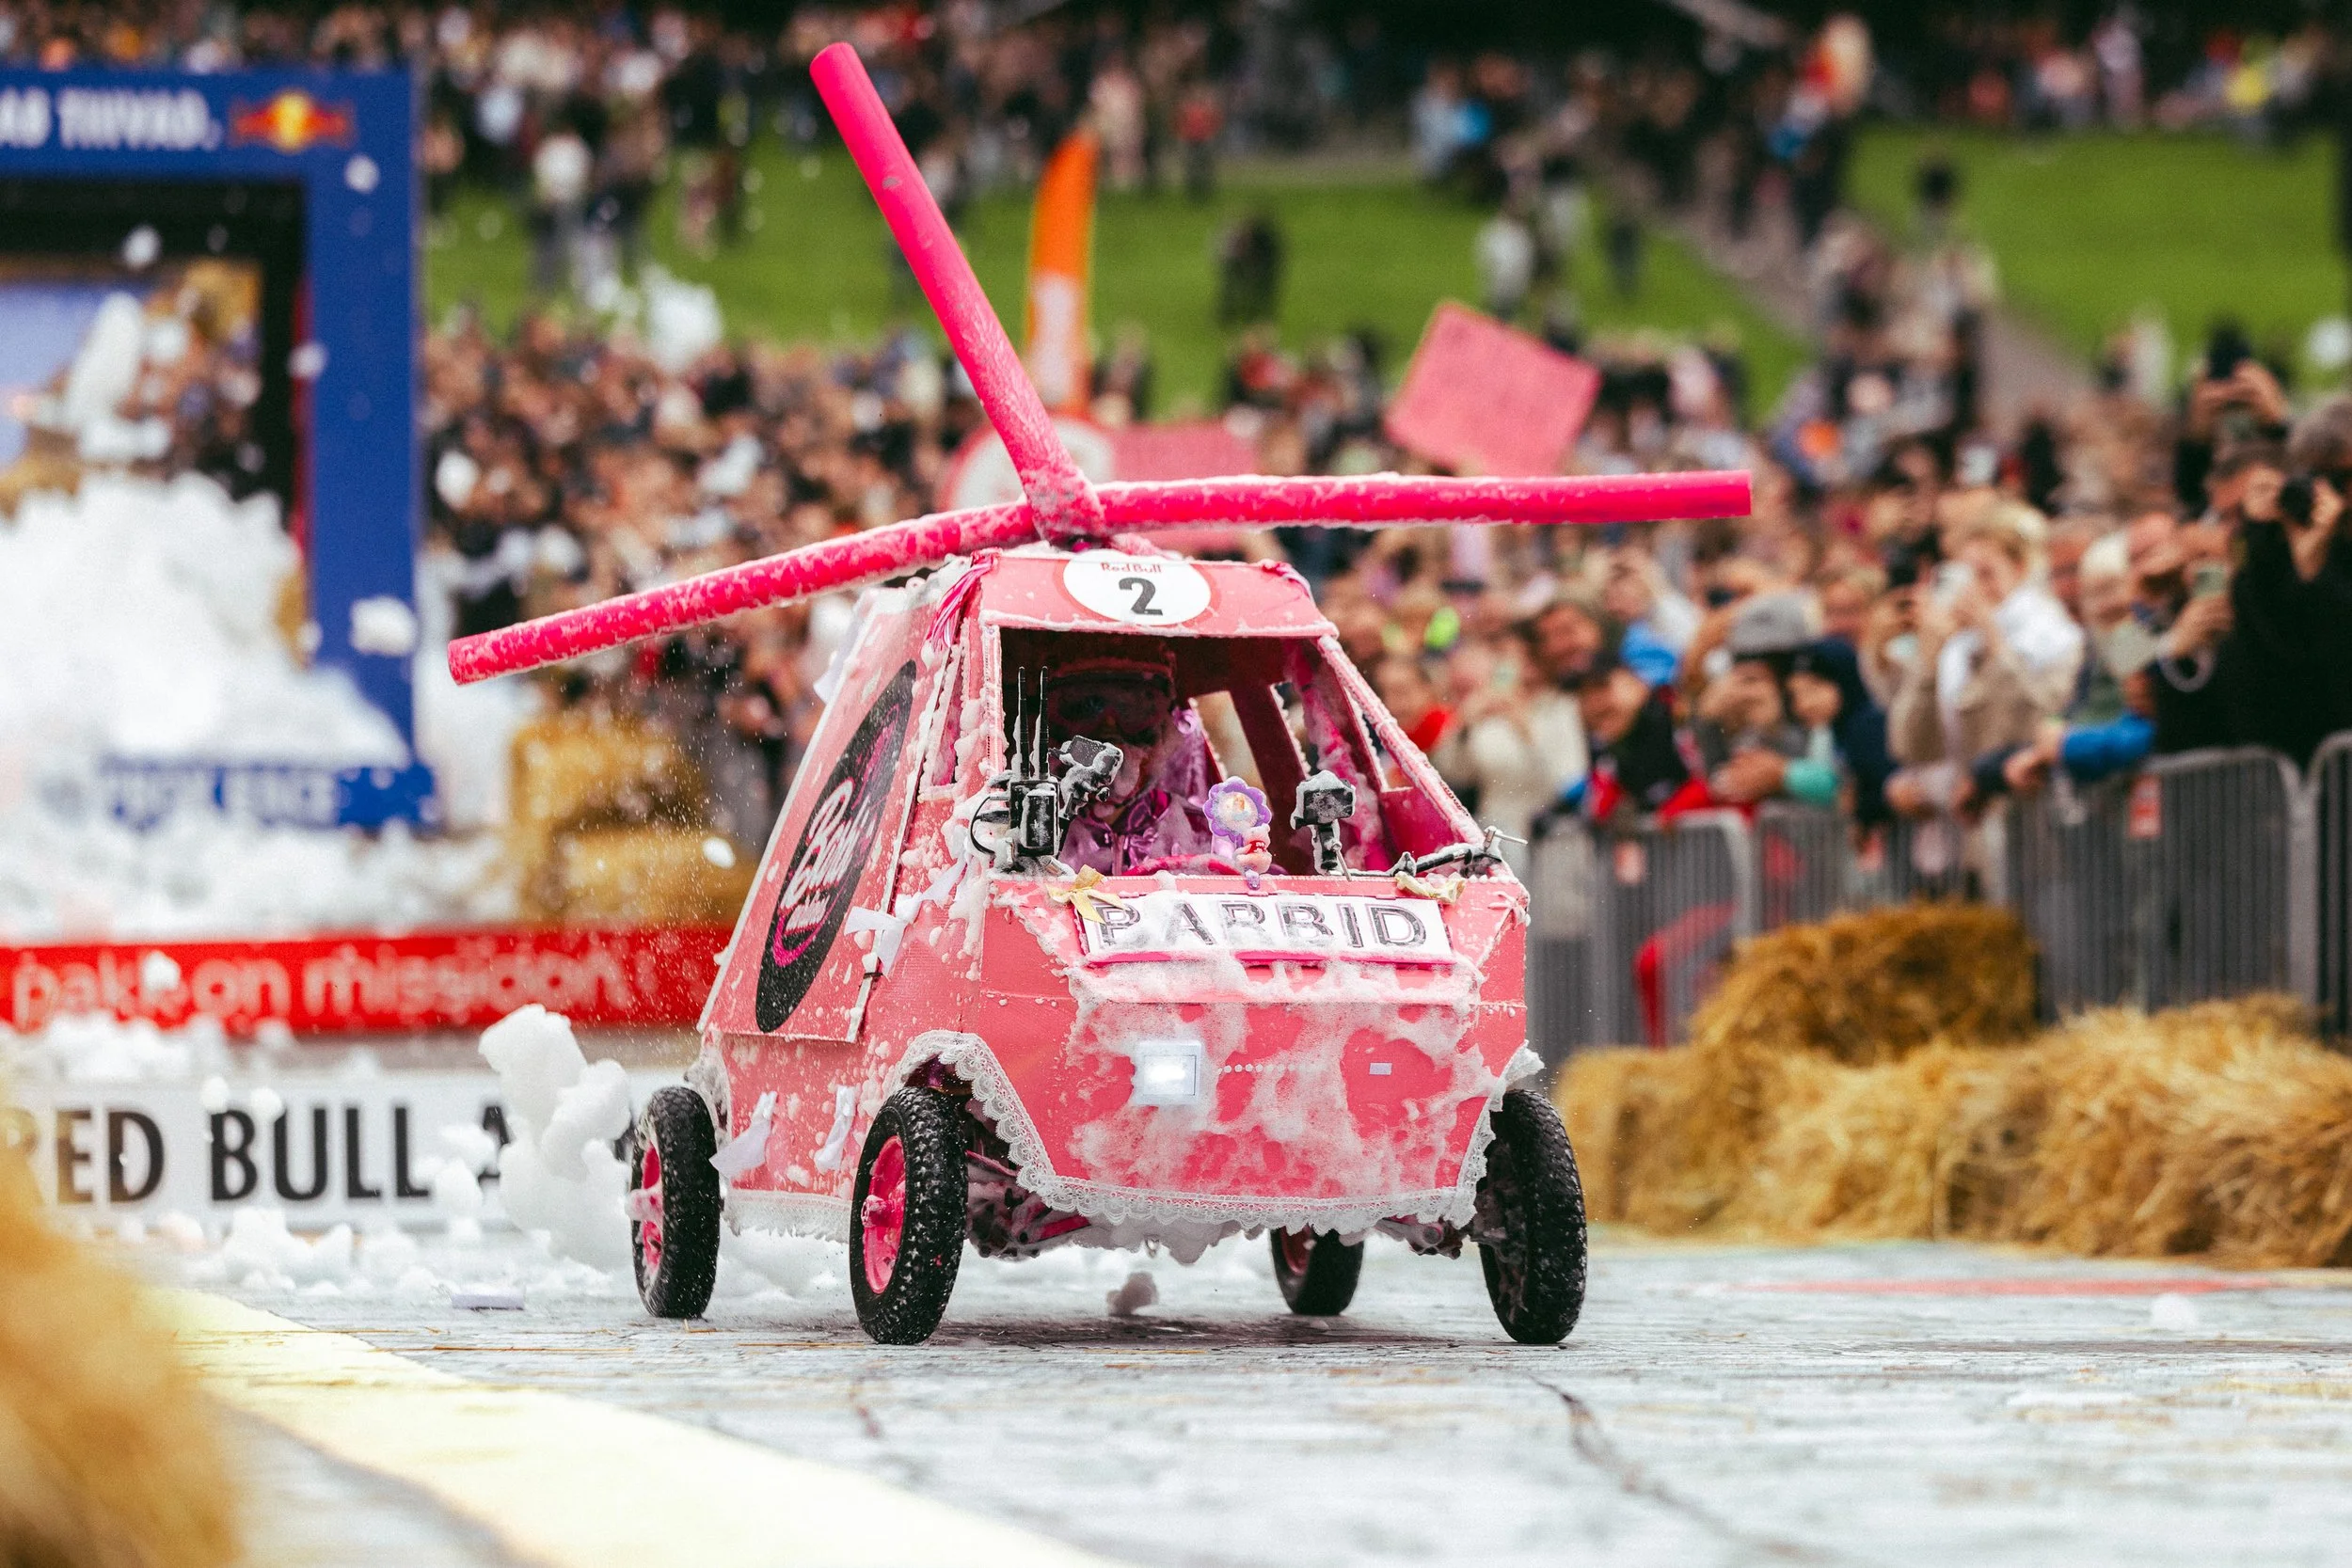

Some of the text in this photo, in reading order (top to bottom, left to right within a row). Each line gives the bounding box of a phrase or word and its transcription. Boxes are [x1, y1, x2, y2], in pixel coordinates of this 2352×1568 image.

[1101, 562, 1162, 574] Red Bull
[1118, 577, 1164, 616] 2
[191, 958, 292, 1018] on
[209, 1104, 432, 1203] BULL
